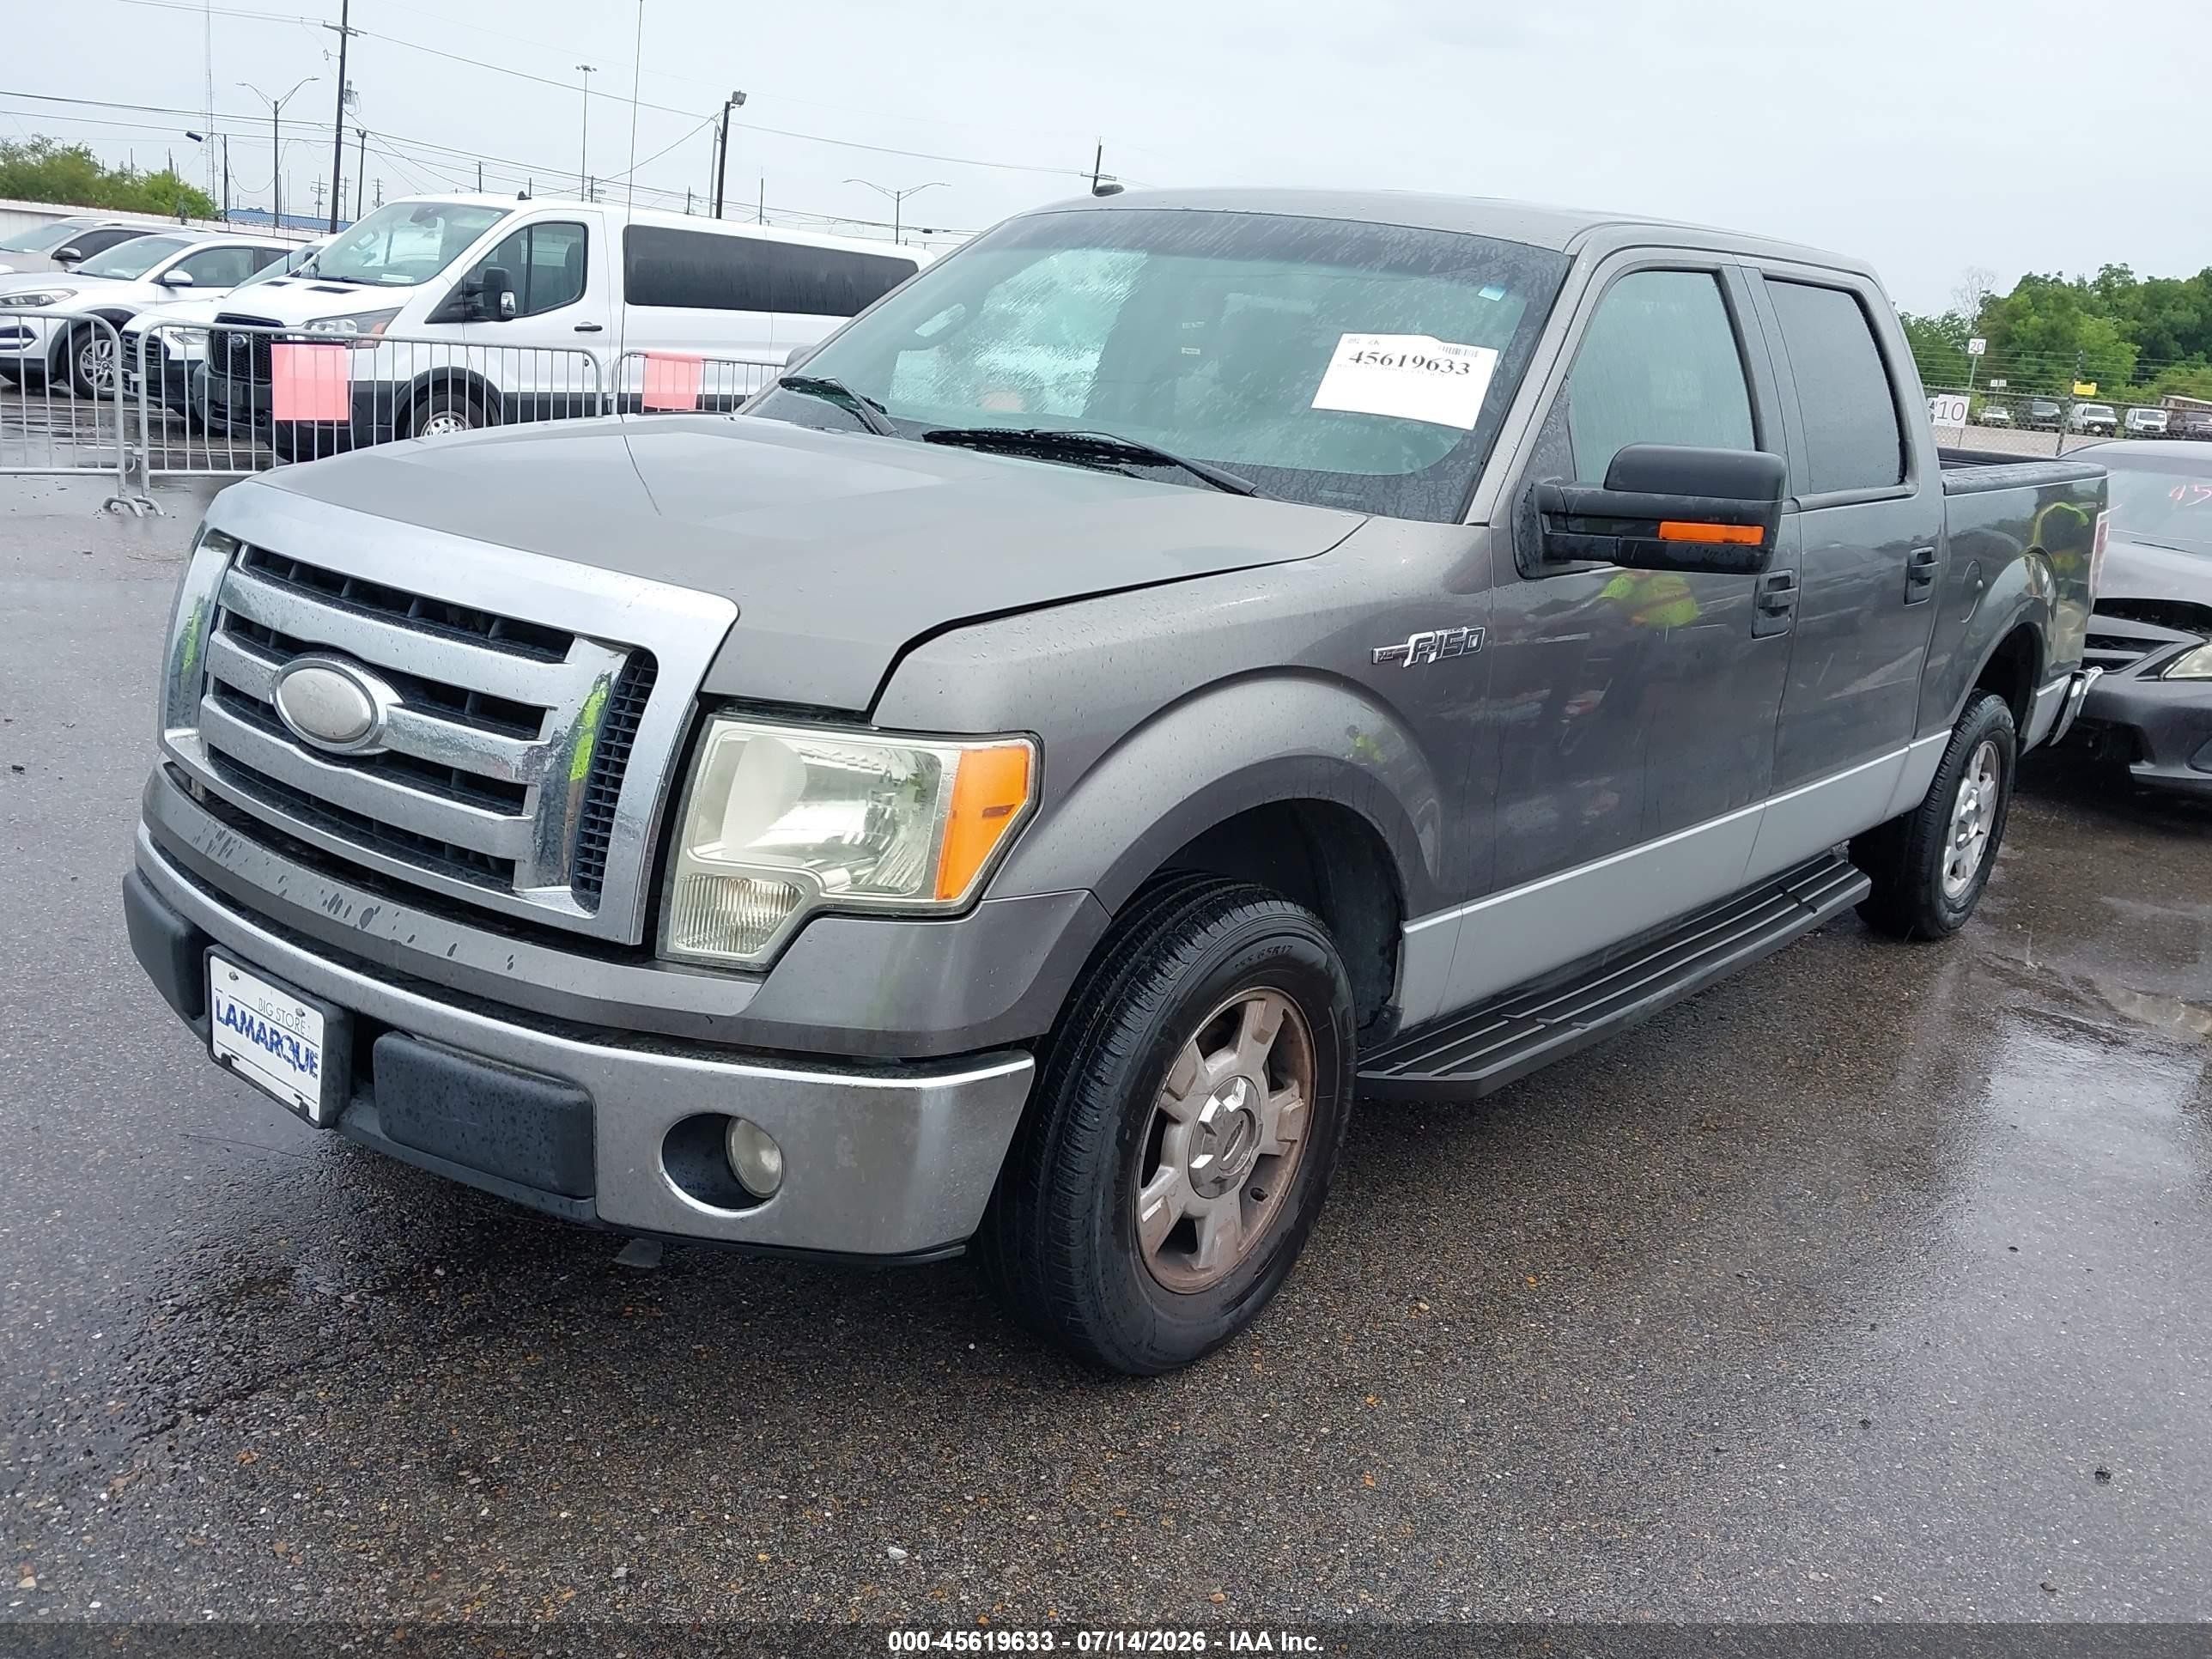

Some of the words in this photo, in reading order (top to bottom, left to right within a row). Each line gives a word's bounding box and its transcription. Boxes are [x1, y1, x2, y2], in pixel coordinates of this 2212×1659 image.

[1970, 342, 1984, 352] 20
[1348, 349, 1472, 376] 45619633
[1936, 400, 1966, 422] 10
[258, 997, 274, 1018] BIG
[275, 1007, 307, 1036] STORE
[215, 995, 319, 1080] LAMARQUE
